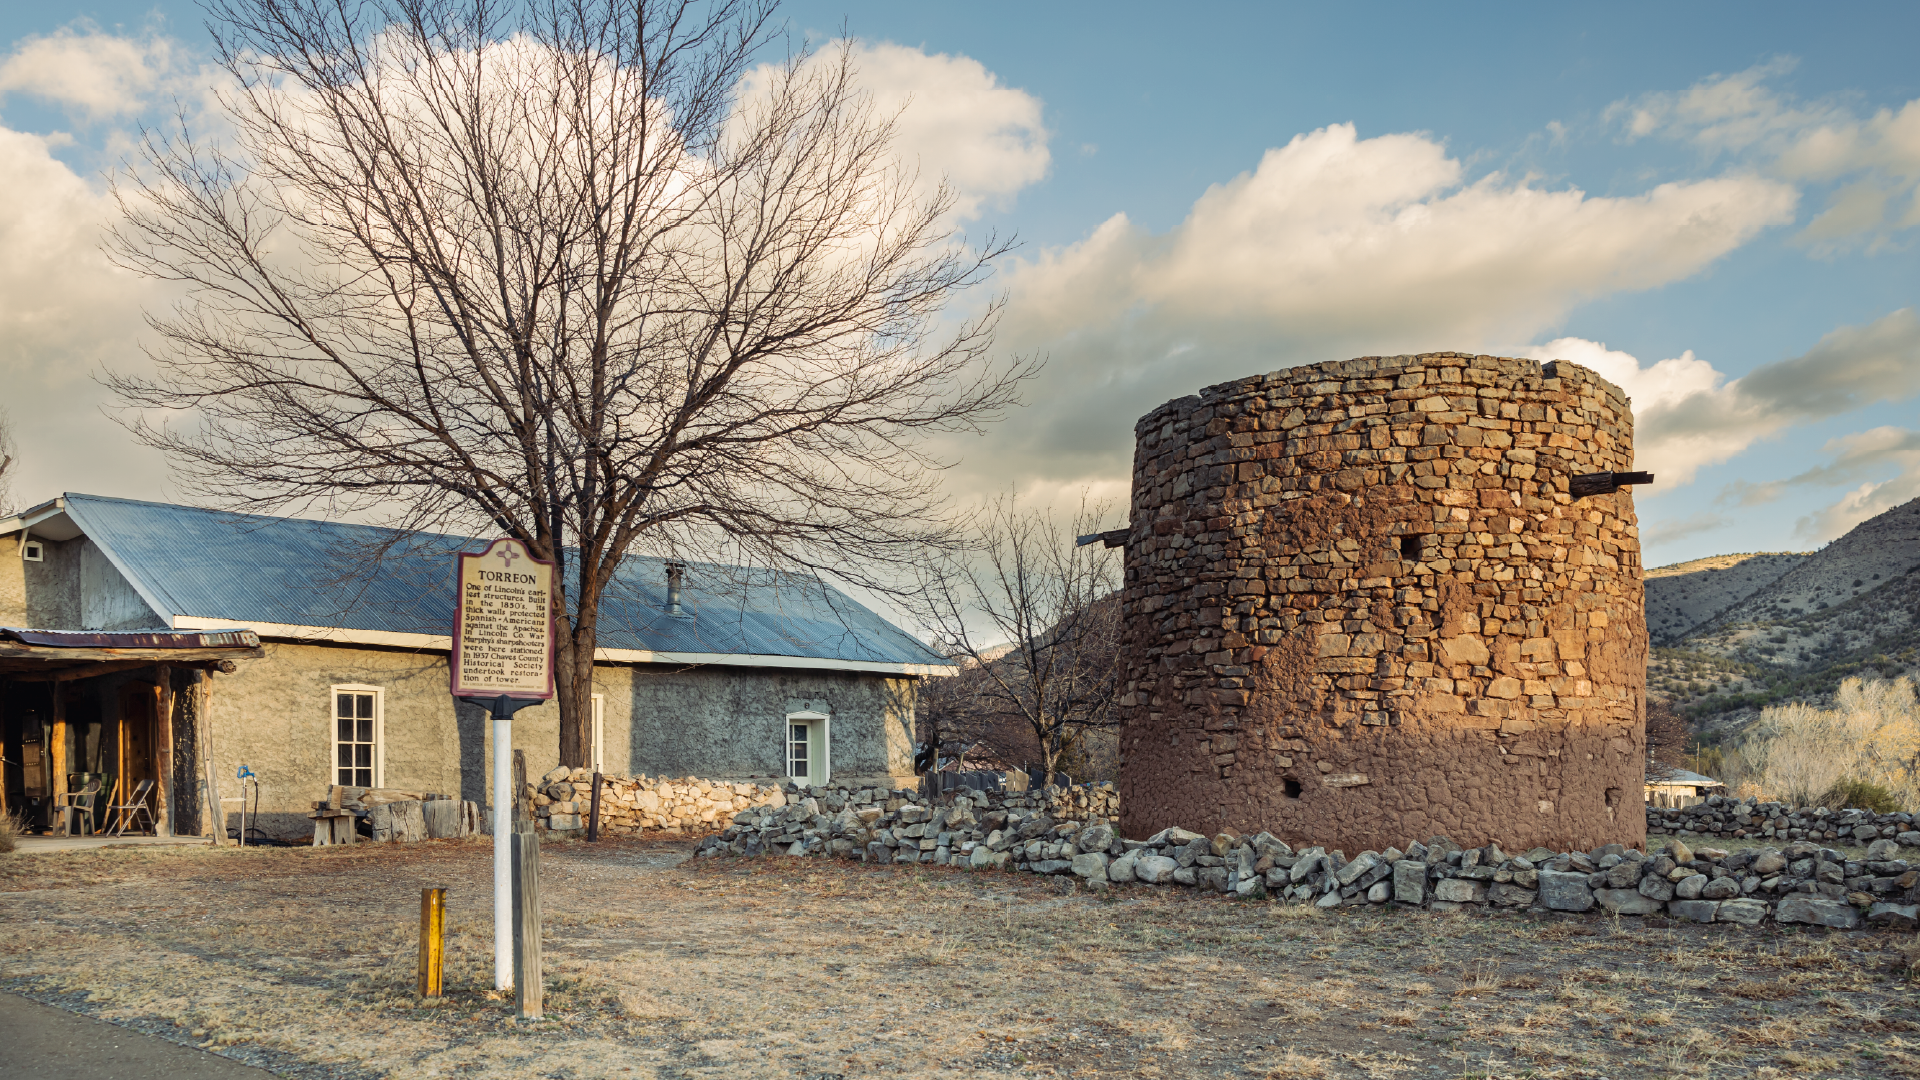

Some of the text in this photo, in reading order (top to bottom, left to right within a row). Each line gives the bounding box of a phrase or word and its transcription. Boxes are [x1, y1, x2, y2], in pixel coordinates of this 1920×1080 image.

[478, 570, 536, 584] TORREON
[495, 585, 525, 594] Lincoln's
[465, 622, 492, 630] against
[464, 636, 544, 647] Murphy's sharpshooters
[518, 655, 544, 663] County
[464, 659, 543, 670] Historical Society
